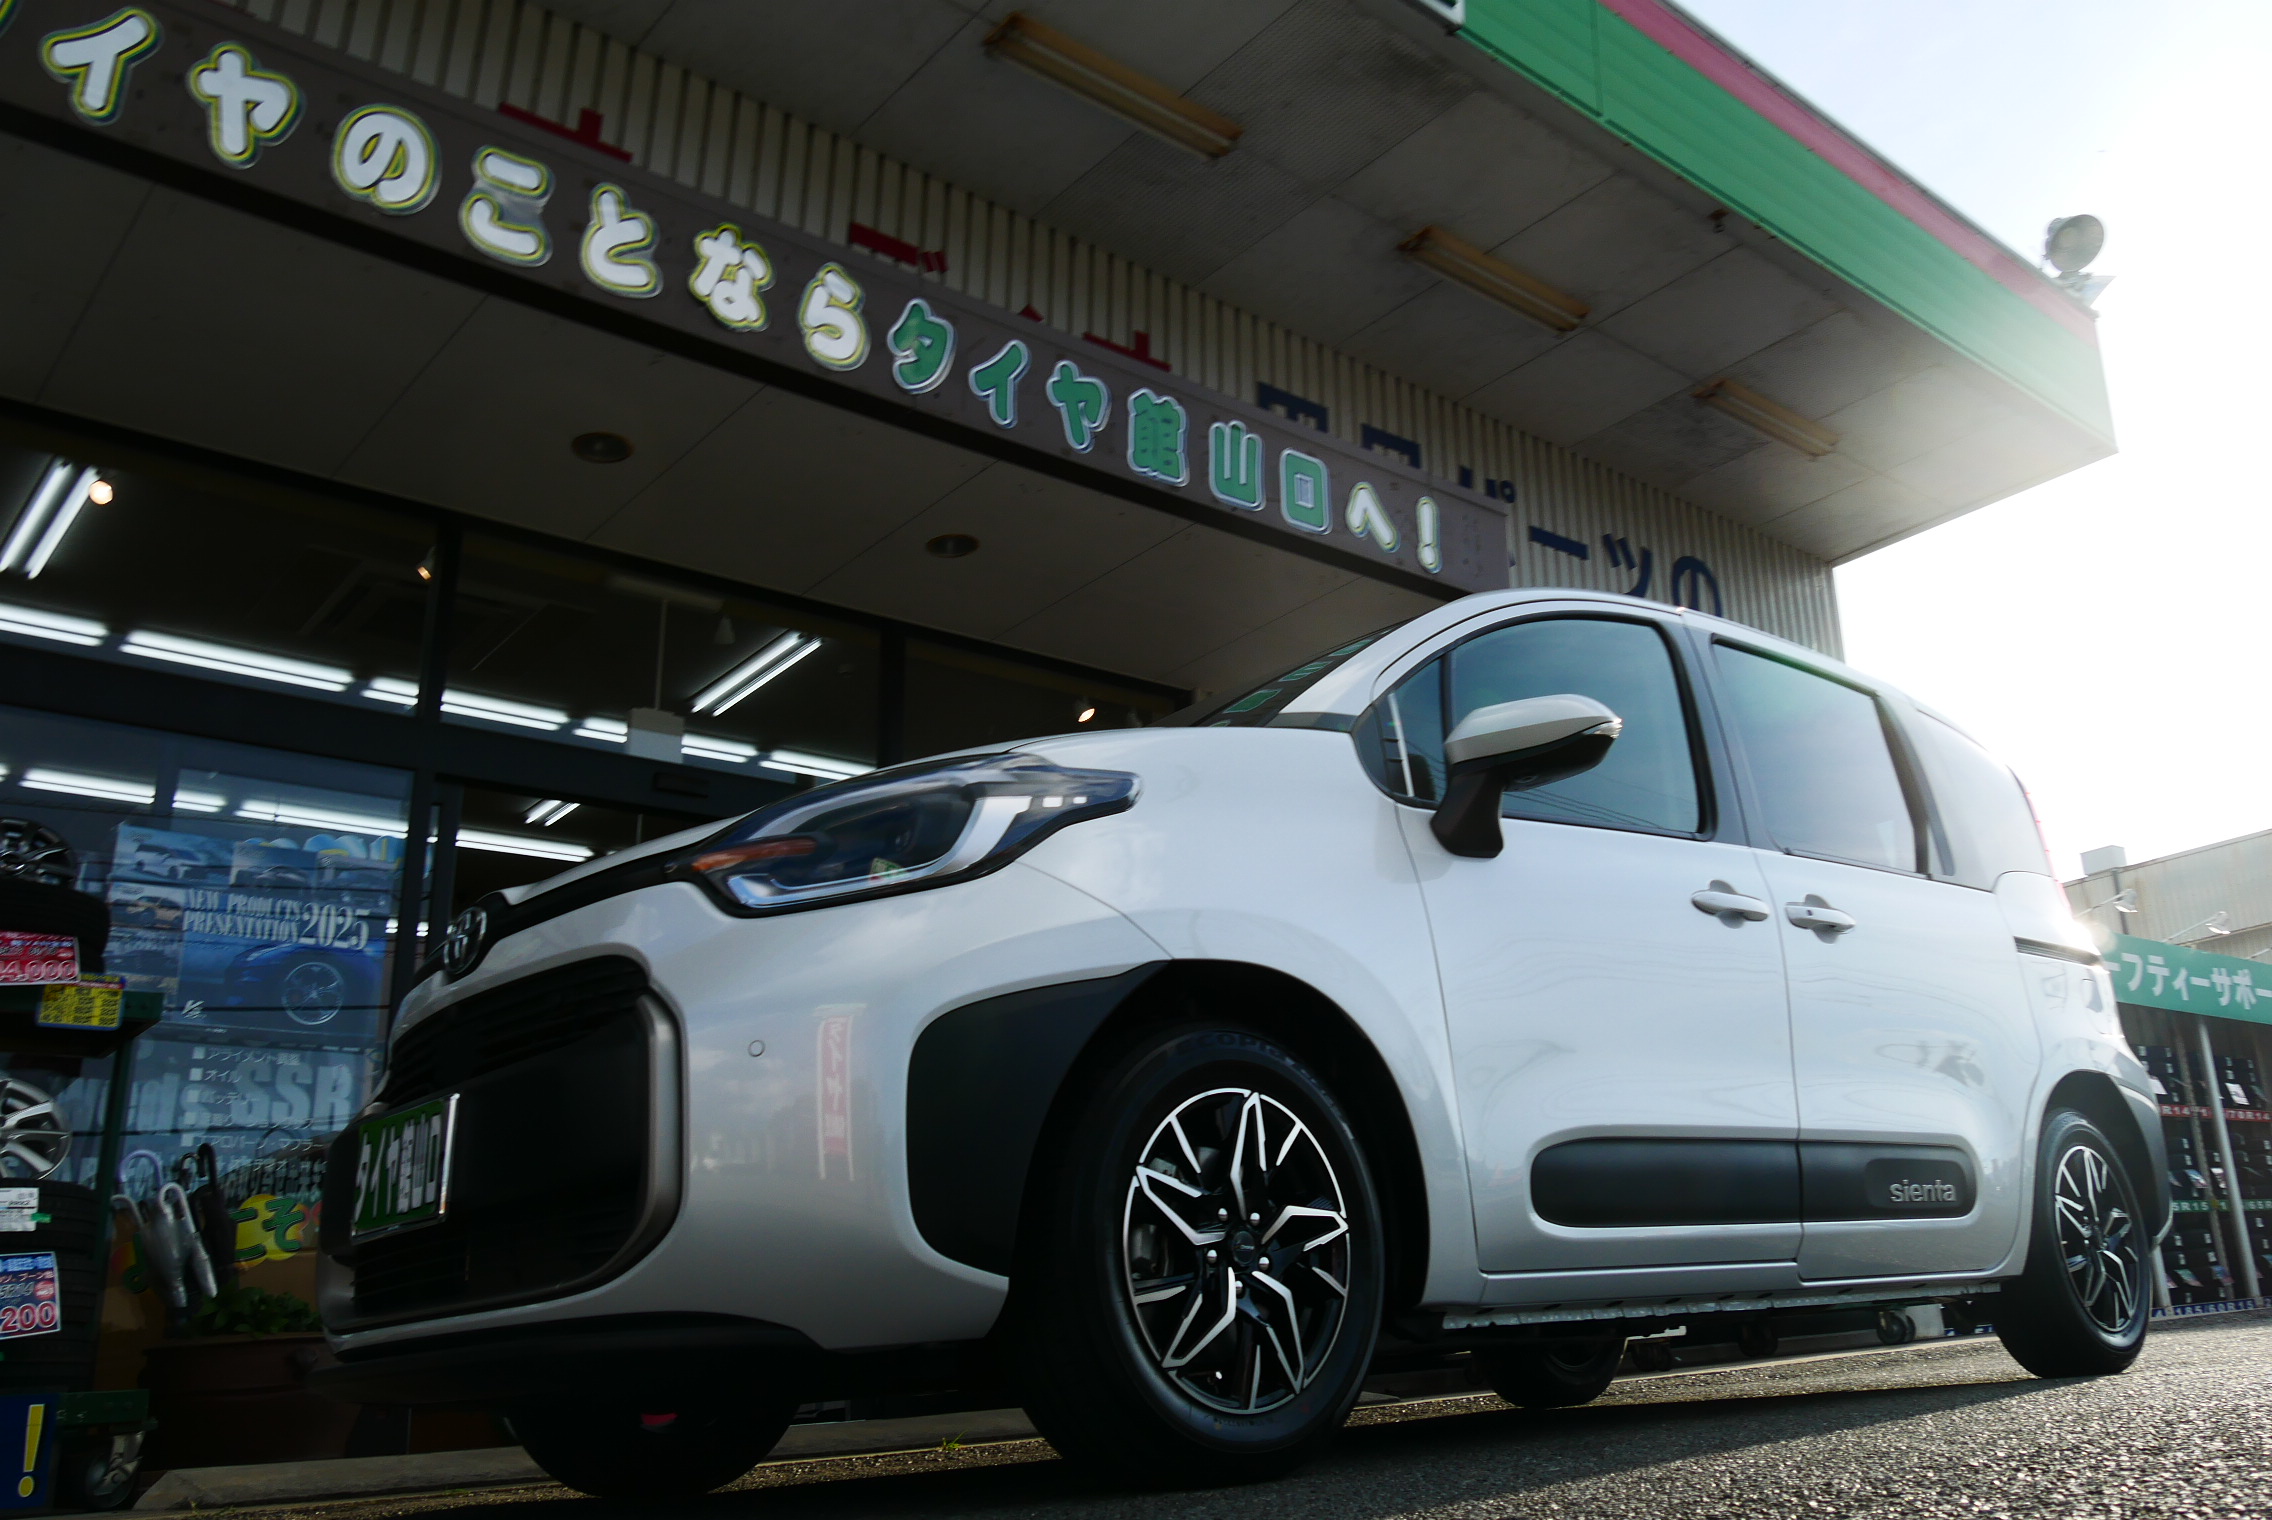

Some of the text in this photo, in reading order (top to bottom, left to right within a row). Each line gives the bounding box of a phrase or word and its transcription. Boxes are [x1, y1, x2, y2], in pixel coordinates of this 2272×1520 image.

[0, 0, 1442, 574] イヤのことならタイヤ館山口へ!
[299, 902, 370, 950] 2025
[354, 1112, 442, 1224] タイヤ館山口
[1889, 1179, 1957, 1202] sienta
